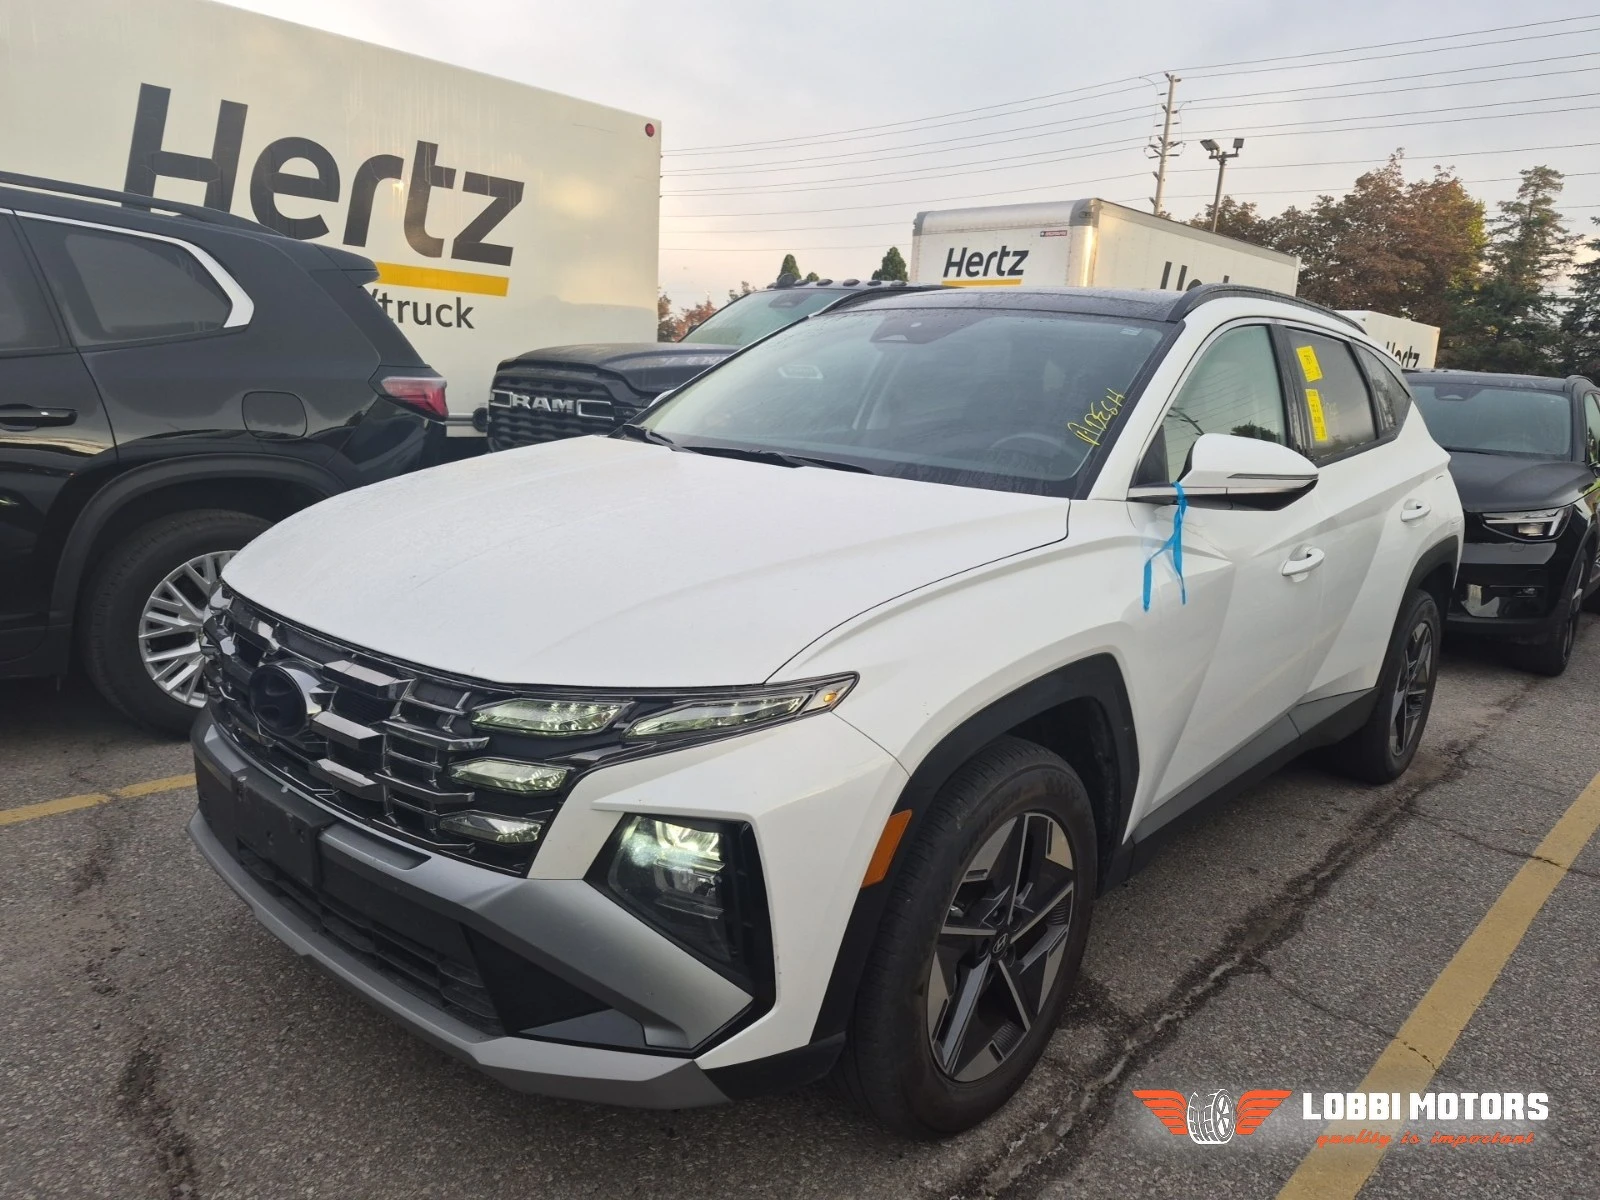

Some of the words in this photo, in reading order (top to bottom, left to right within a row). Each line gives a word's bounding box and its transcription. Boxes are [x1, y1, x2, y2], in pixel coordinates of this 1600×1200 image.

[122, 82, 524, 266] Hertz
[943, 245, 1029, 278] Hertz
[511, 393, 575, 413] RAM
